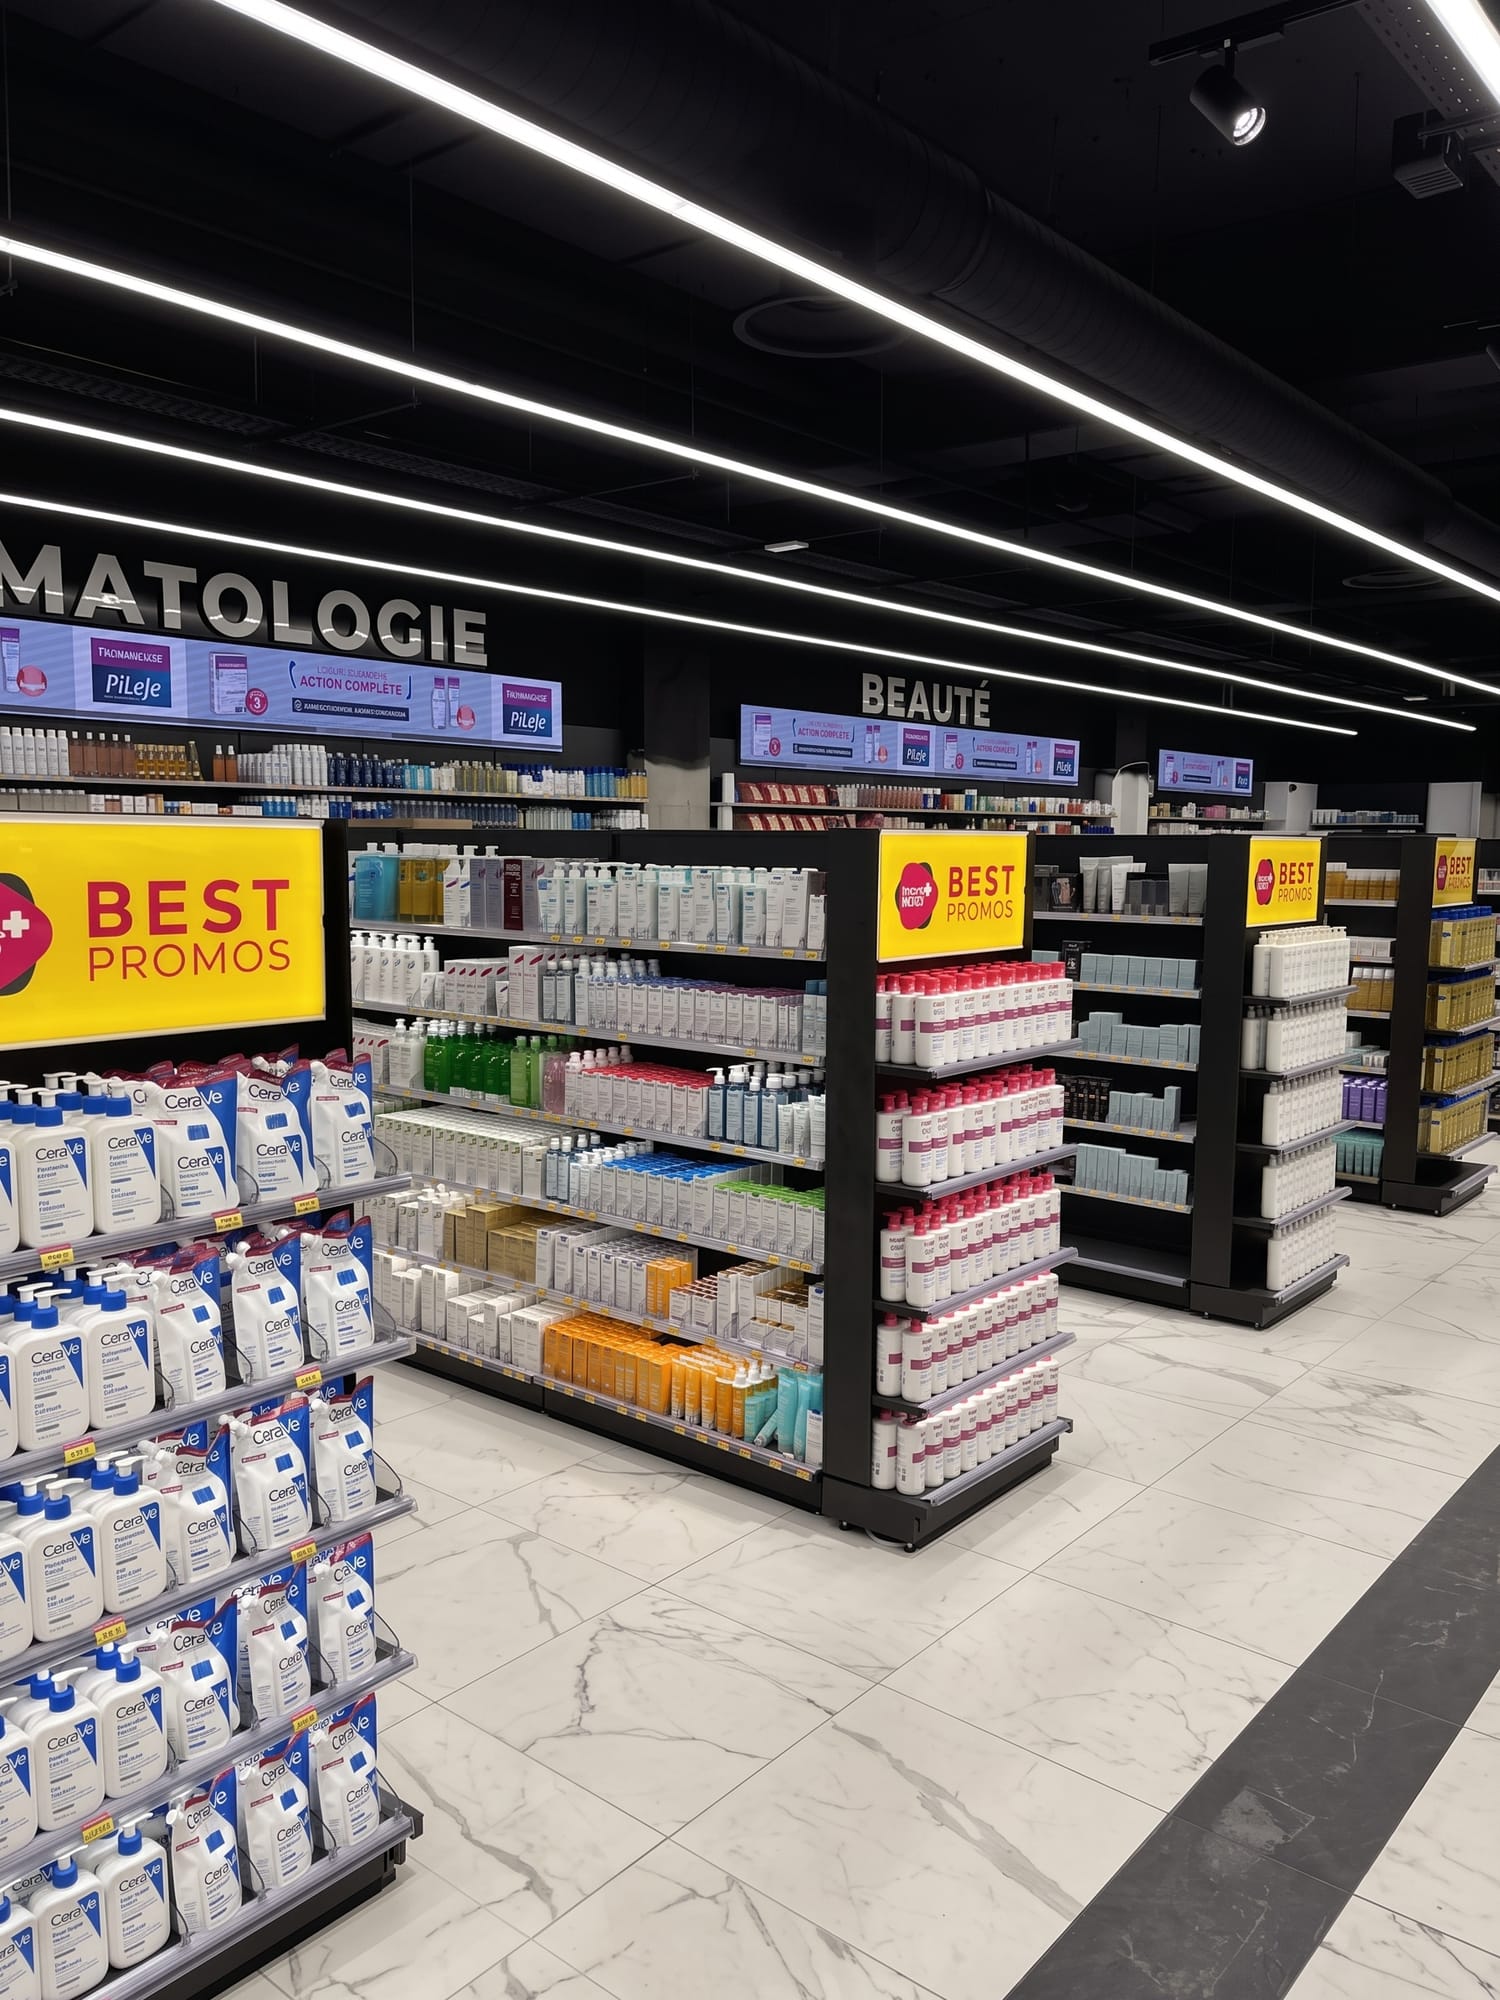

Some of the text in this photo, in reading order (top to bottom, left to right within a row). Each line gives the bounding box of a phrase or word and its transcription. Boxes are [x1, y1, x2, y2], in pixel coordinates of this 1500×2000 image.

[0, 542, 488, 667] MATOLOGIE
[106, 672, 161, 701] PiLeJe
[300, 676, 402, 695] ACTION COMPLÈTE
[862, 673, 991, 727] BEAUTÉ
[510, 711, 546, 730] PiLeJe
[1279, 862, 1314, 885] BEST
[1449, 856, 1471, 874] BEST
[949, 865, 1015, 898] BEST
[1278, 887, 1312, 902] PROMOS
[87, 879, 290, 938] BEST
[947, 900, 1013, 922] PROMOS
[89, 939, 290, 982] PROMOS
[164, 1089, 222, 1110] CeraVe
[248, 1080, 300, 1101] CeraVe
[35, 1141, 84, 1161] CeraVe
[108, 1132, 152, 1150] CeraVe
[256, 1140, 301, 1157] CeraVe
[177, 1152, 224, 1170] CeraVe
[248, 1253, 292, 1275] CeraVe
[170, 1270, 214, 1293] CeraVe
[100, 1324, 144, 1346] CeraVe
[32, 1344, 80, 1364] CeraVe
[329, 1397, 366, 1422] CeraVe
[252, 1419, 300, 1444] CeraVe
[113, 1508, 158, 1531] CeraVe
[43, 1534, 90, 1556] CeraVe
[173, 1621, 222, 1651] CeraVe
[116, 1692, 160, 1719] CeraVe
[184, 1686, 227, 1712] CeraVe
[48, 1724, 94, 1750] CeraVe
[332, 1717, 369, 1752] CeraVe
[186, 1790, 226, 1828] CeraVe
[119, 1864, 161, 1893] CeraVe
[51, 1899, 96, 1927] CeraVe
